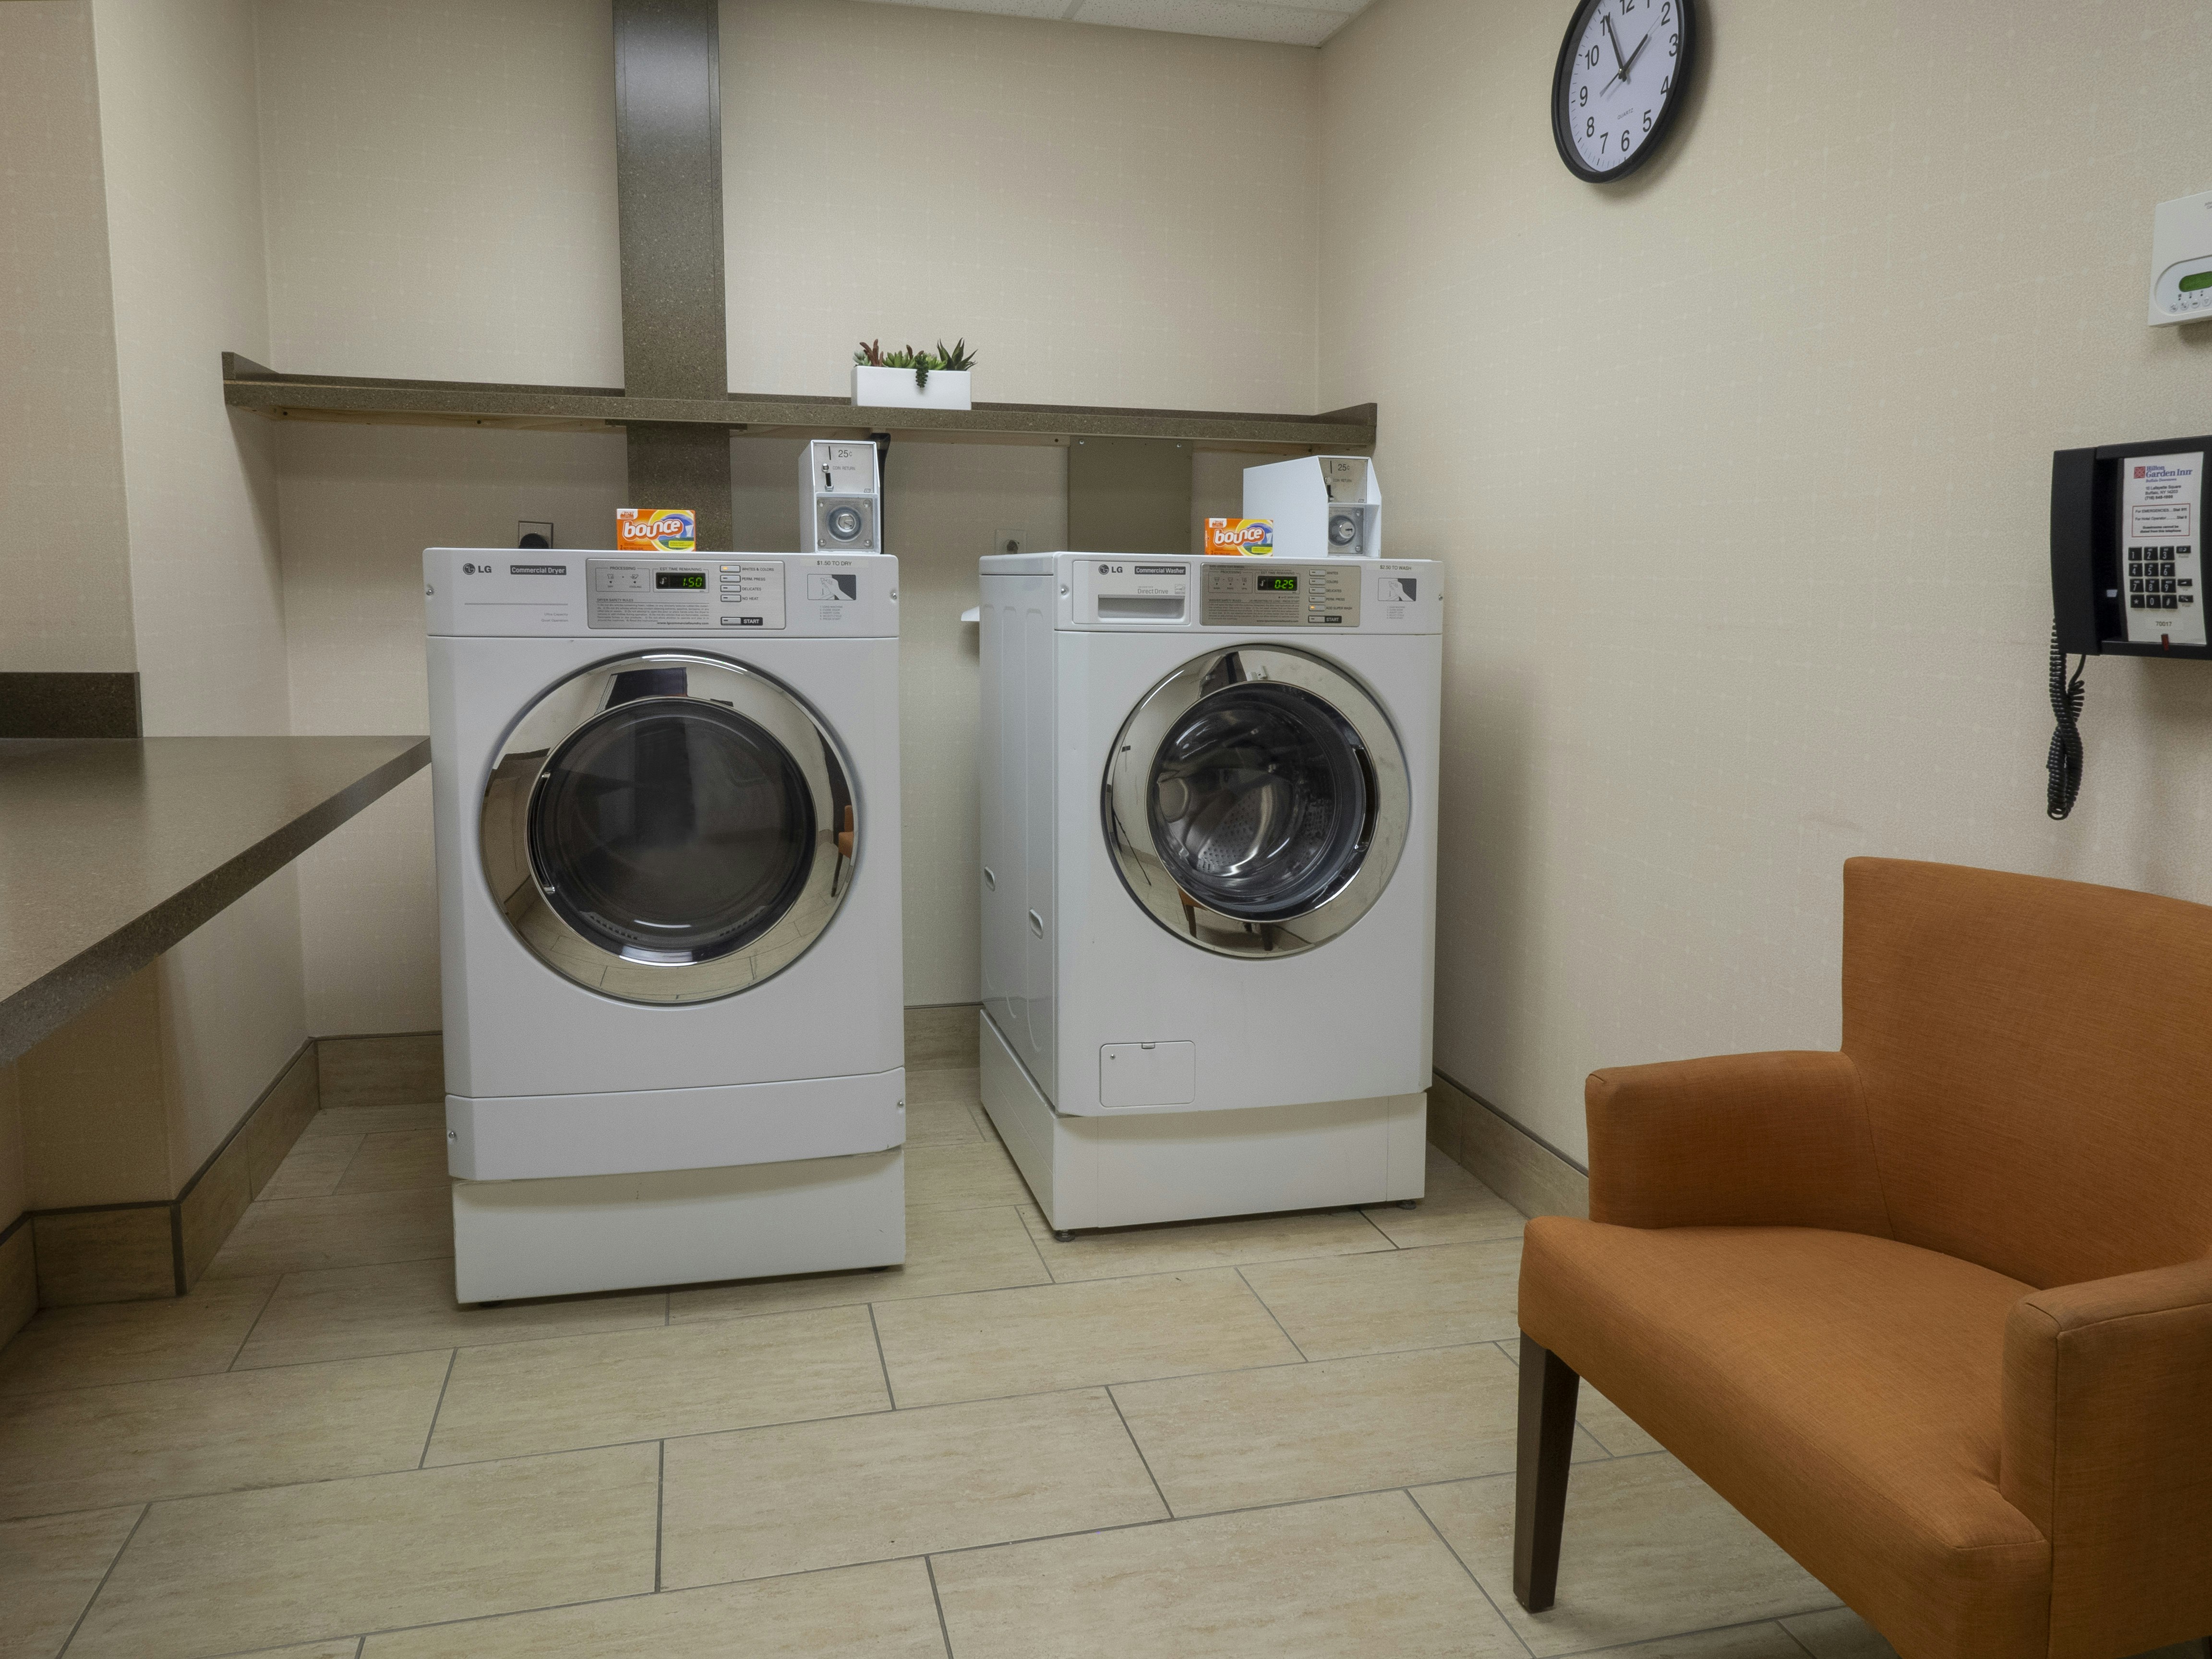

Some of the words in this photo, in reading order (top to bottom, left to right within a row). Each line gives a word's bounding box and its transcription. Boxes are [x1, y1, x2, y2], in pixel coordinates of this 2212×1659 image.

[1661, 1, 1671, 26] 2
[1669, 33, 1678, 57] 3
[1585, 45, 1599, 70] 10
[1580, 85, 1588, 107] 9
[1660, 75, 1670, 95] 4
[1617, 108, 1634, 120] QUARTZ
[1643, 109, 1652, 132] 5
[1587, 116, 1595, 138] 8
[1600, 132, 1609, 154] 7
[1621, 130, 1630, 152] 6
[624, 520, 682, 539] bounce
[1214, 528, 1263, 545] bounce
